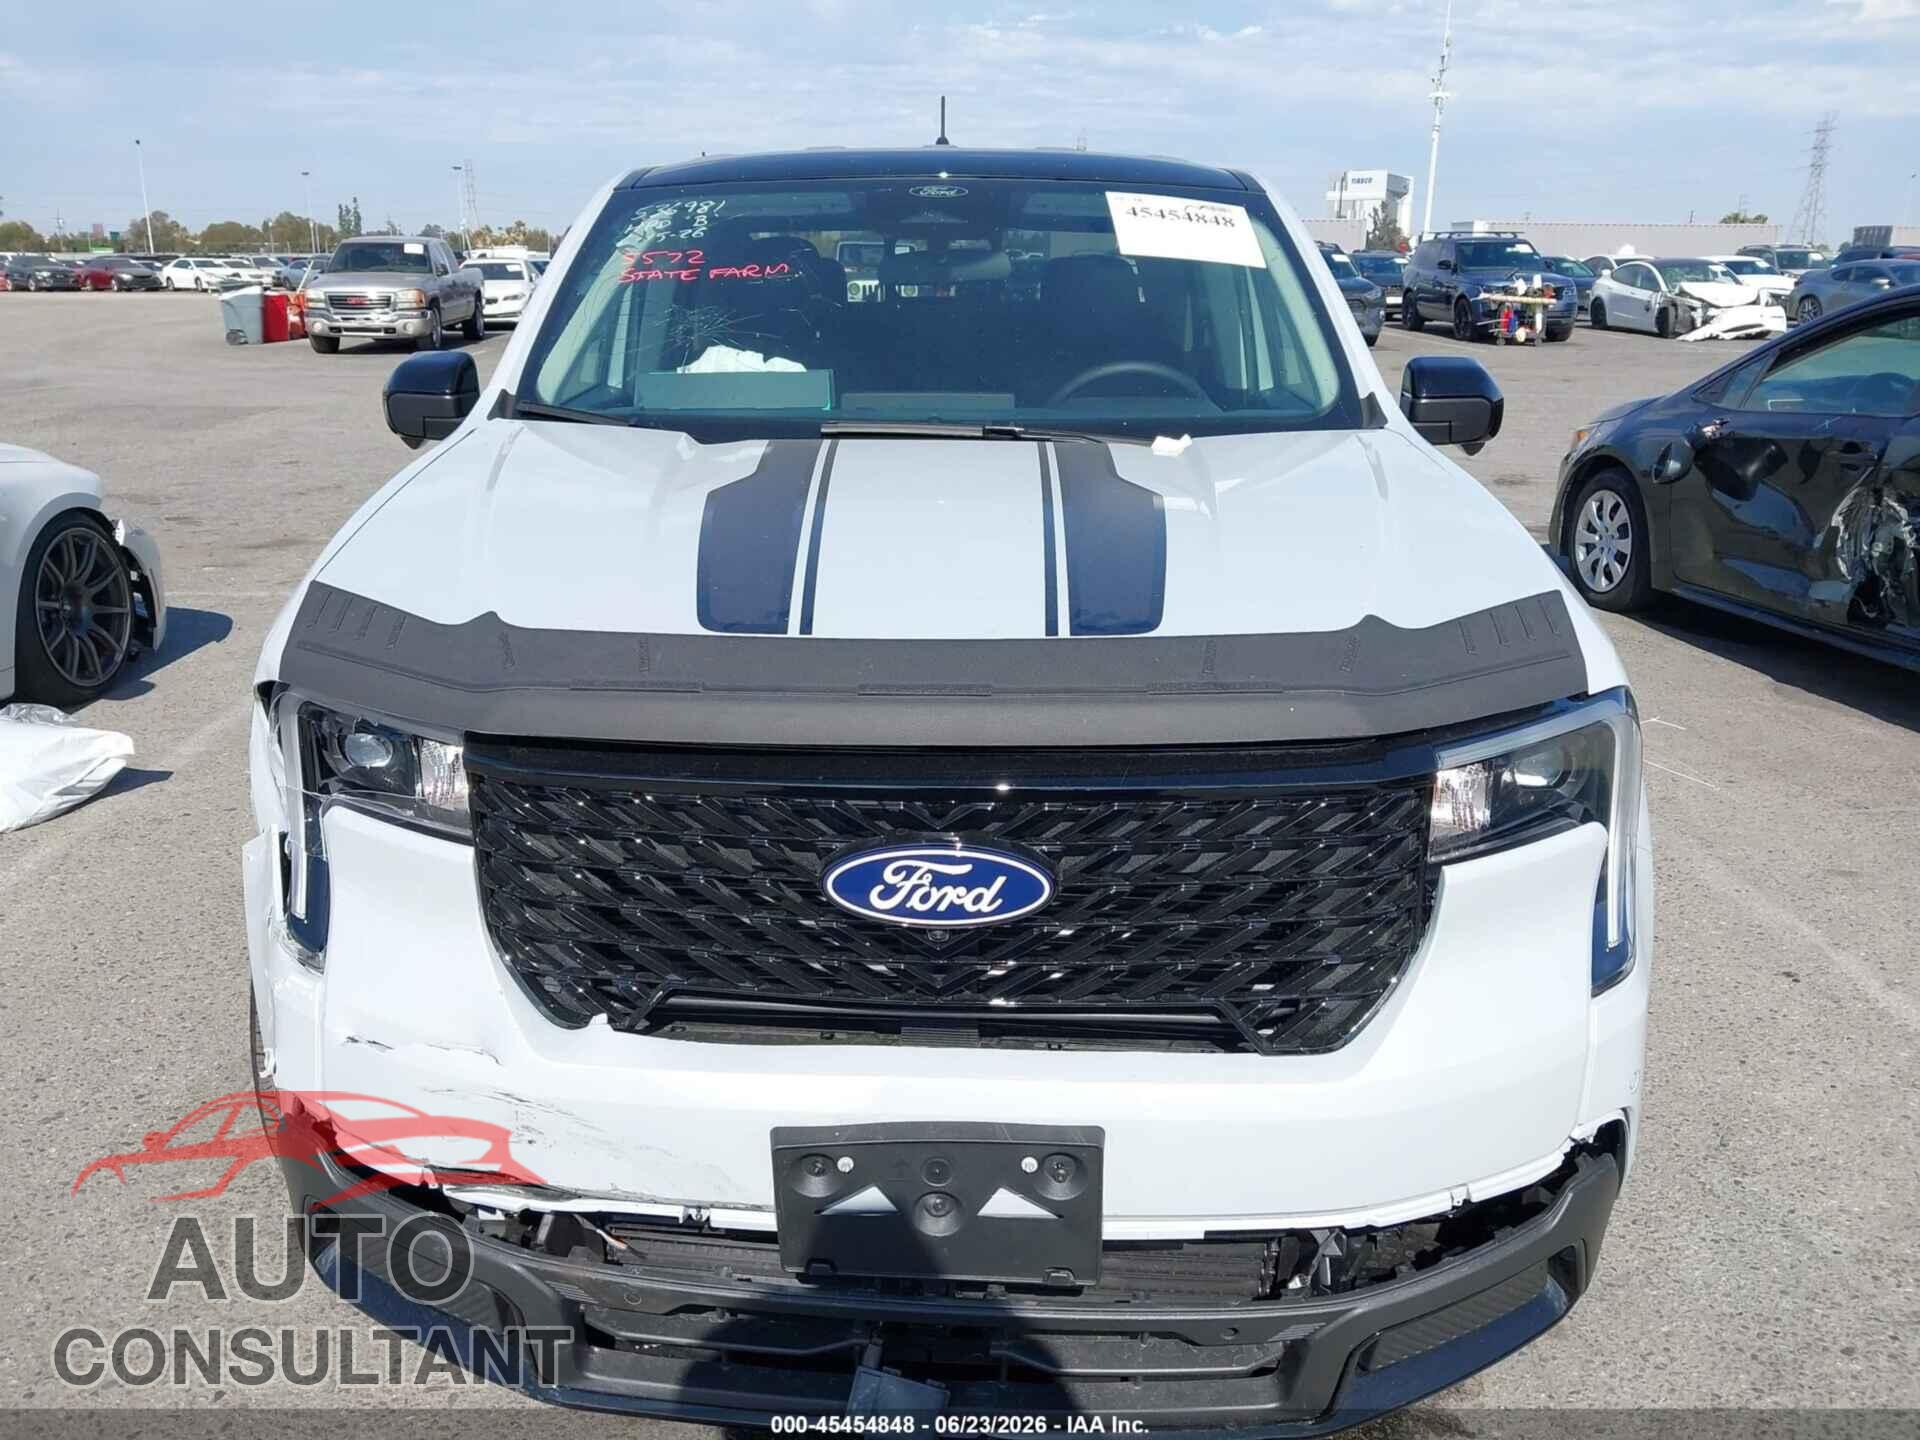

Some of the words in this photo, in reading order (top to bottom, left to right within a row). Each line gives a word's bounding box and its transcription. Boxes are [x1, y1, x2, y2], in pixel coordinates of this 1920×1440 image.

[1126, 205, 1236, 228] 45454848
[617, 266, 702, 284] STATE
[708, 263, 789, 280] FARM
[868, 859, 1008, 913] Ford
